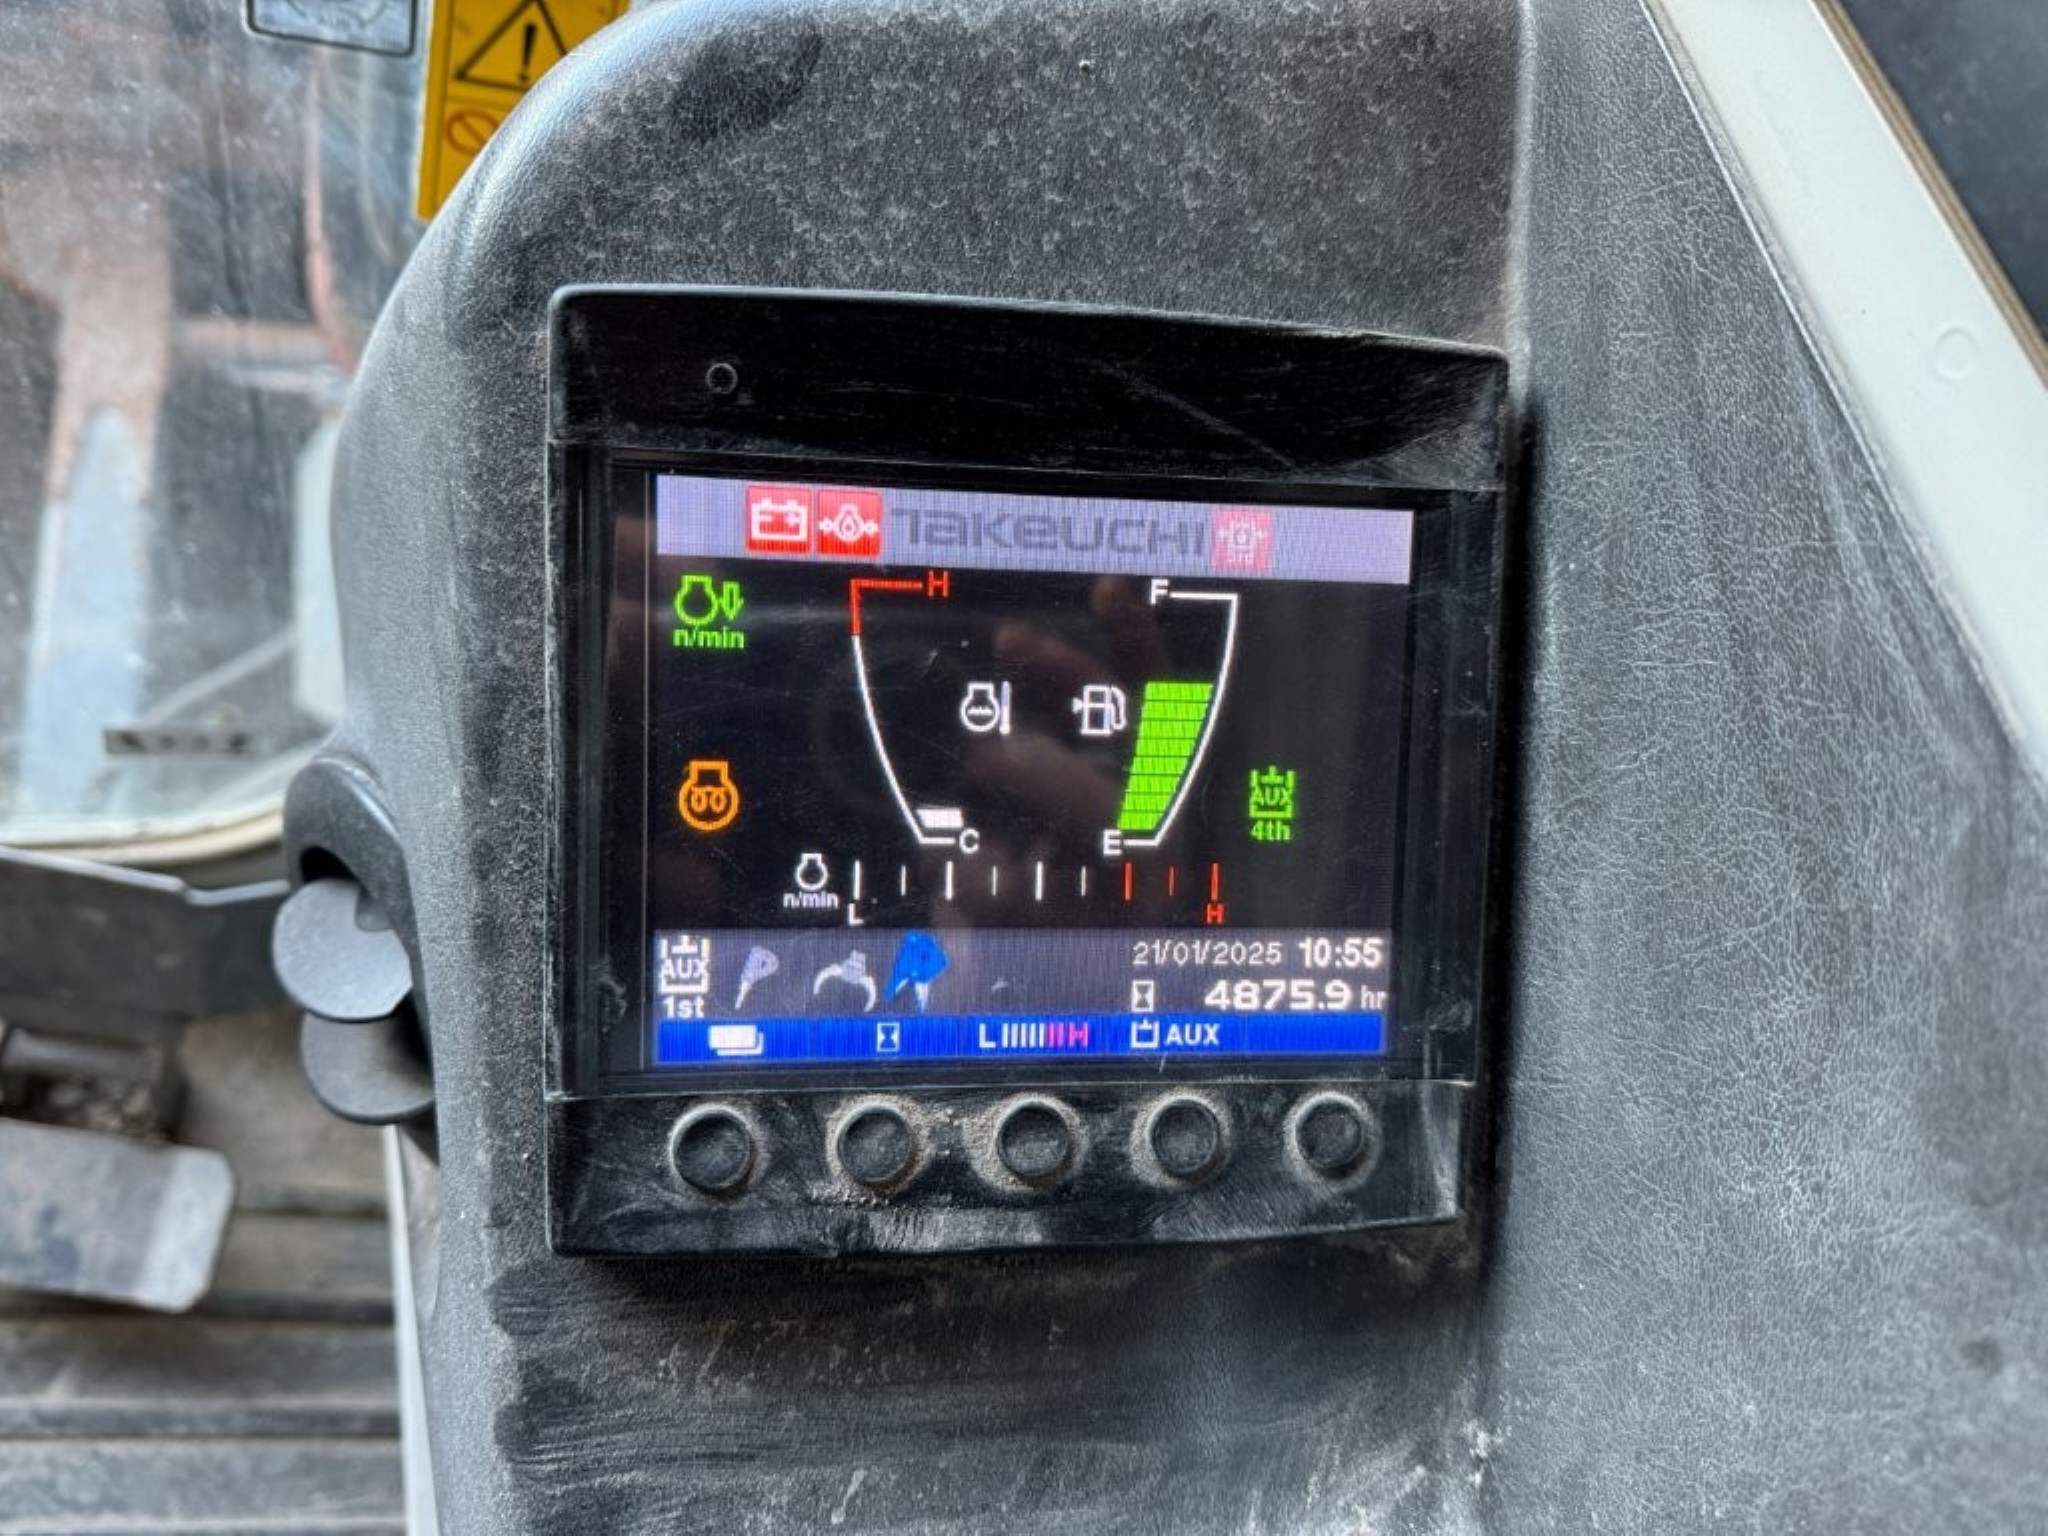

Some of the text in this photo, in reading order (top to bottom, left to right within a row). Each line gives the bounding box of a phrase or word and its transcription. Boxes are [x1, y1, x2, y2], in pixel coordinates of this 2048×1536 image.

[926, 570, 949, 598] H
[1149, 579, 1169, 606] F
[672, 626, 745, 649] n/min
[958, 828, 980, 855] C
[1102, 828, 1123, 856] E
[1249, 821, 1291, 841] 4th
[782, 891, 839, 909] n/min
[848, 903, 864, 925] L
[1207, 903, 1224, 924] H
[1132, 936, 1385, 968] 21/01/2025 10:55
[663, 997, 705, 1019] 1st
[1204, 979, 1388, 1012] 4875.9 hr
[1164, 1022, 1222, 1047] AUX
